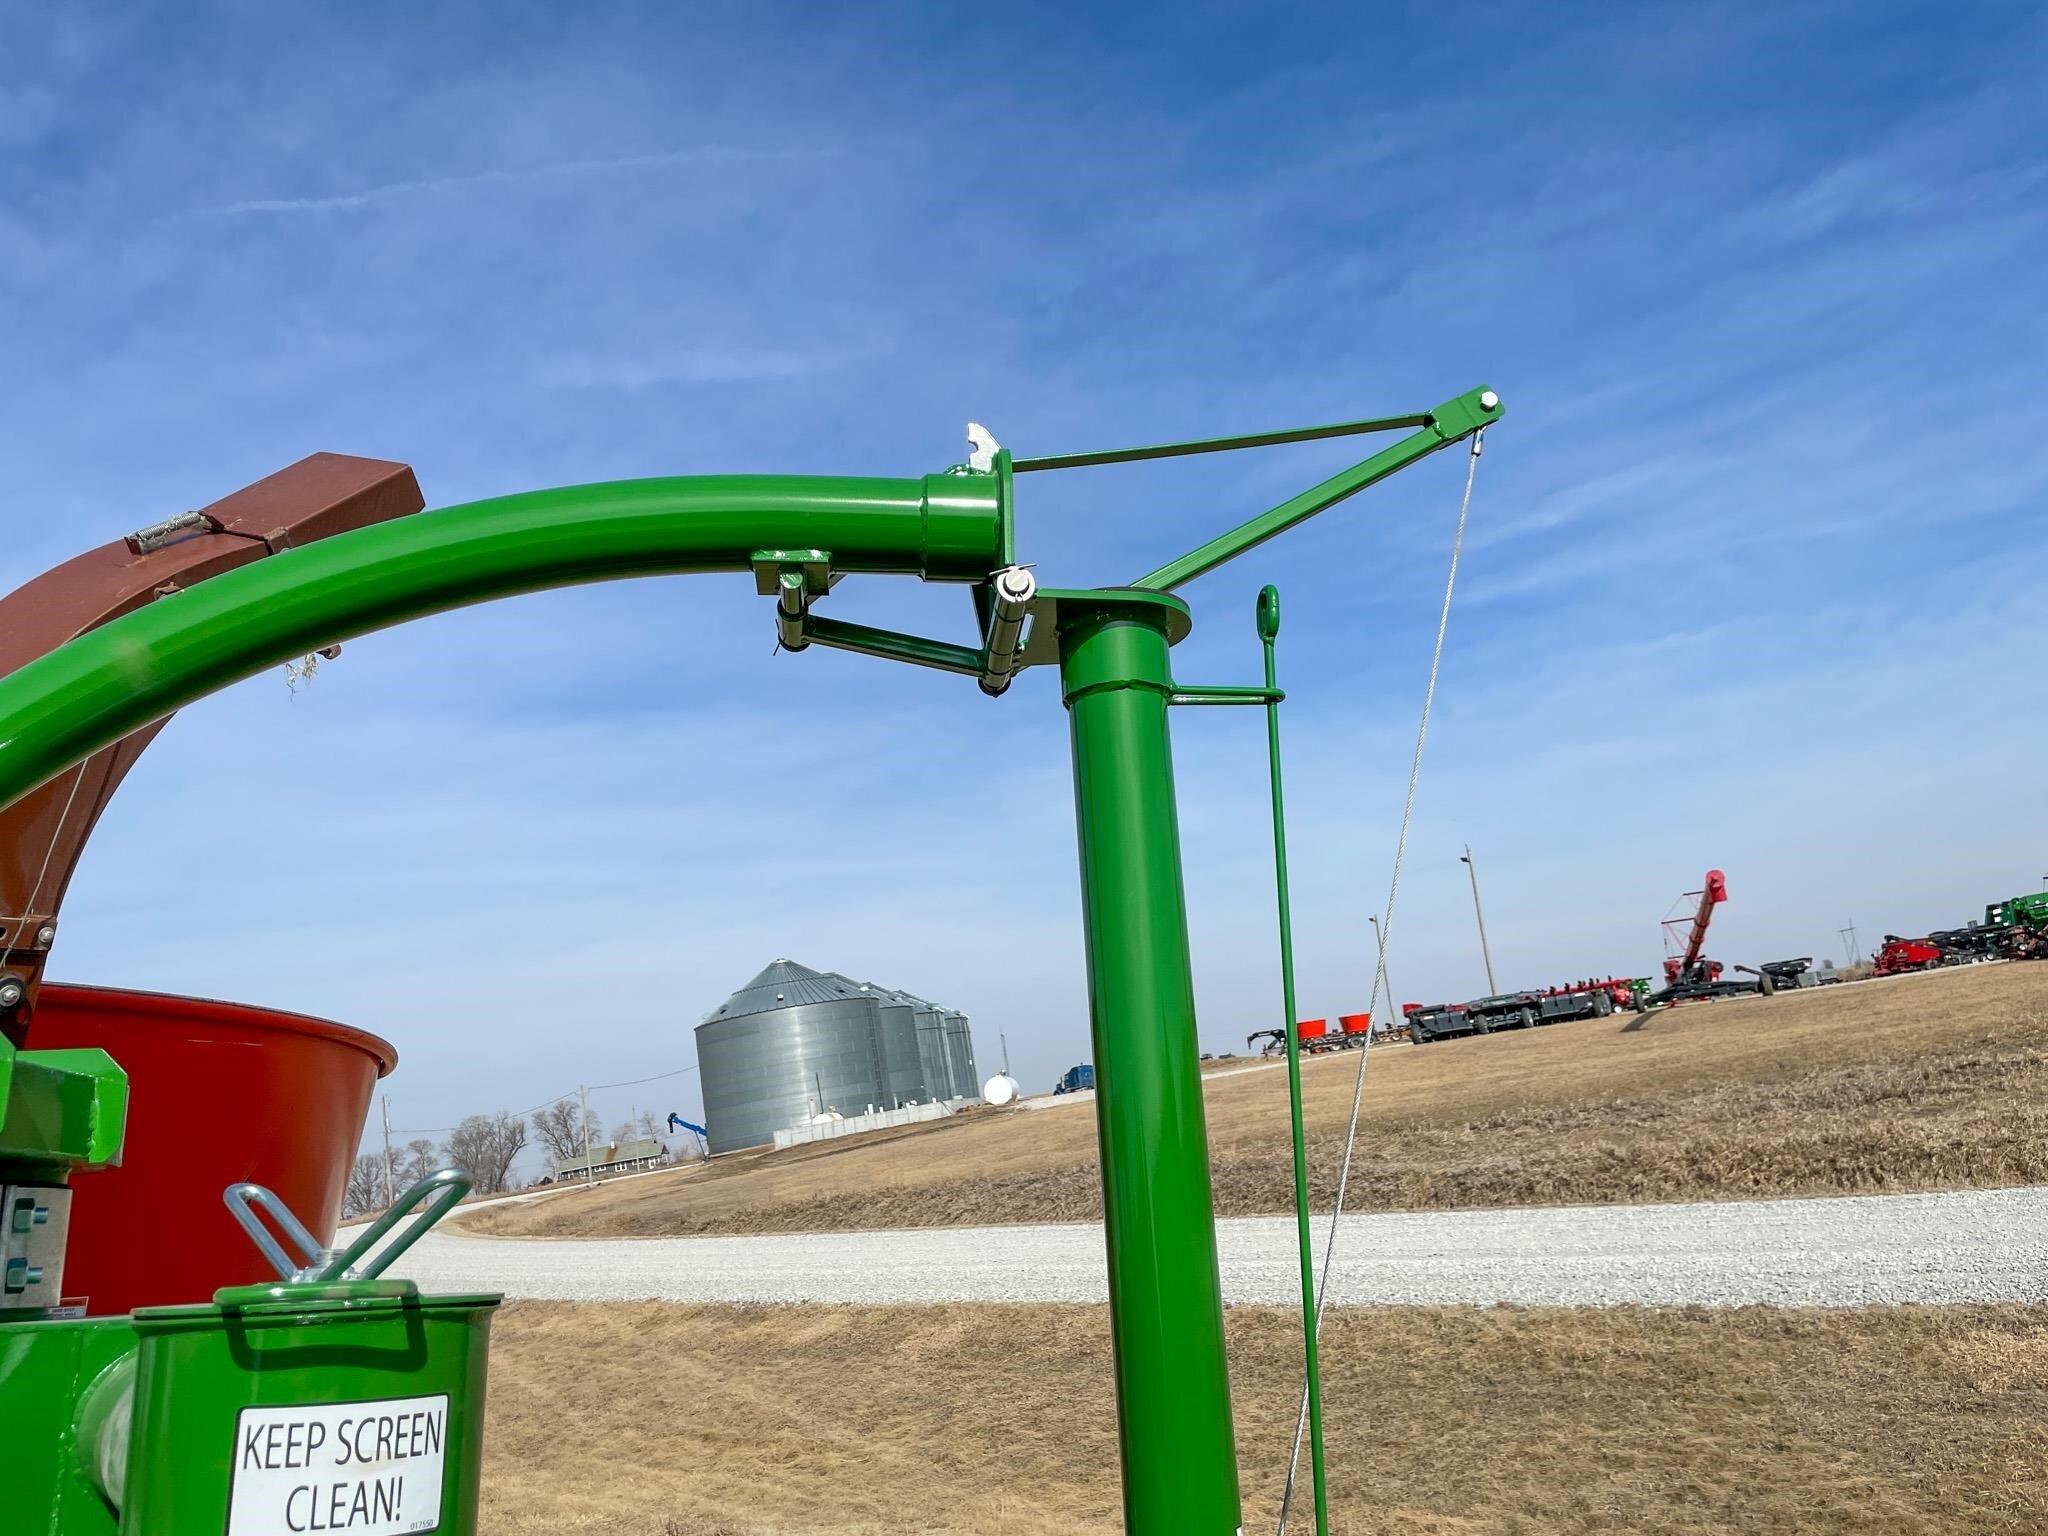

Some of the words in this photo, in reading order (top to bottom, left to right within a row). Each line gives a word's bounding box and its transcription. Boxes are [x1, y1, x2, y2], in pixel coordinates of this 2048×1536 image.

[244, 1421, 326, 1470] KEEP
[335, 1410, 442, 1466] SCREEN
[286, 1476, 403, 1532] CLEAN!
